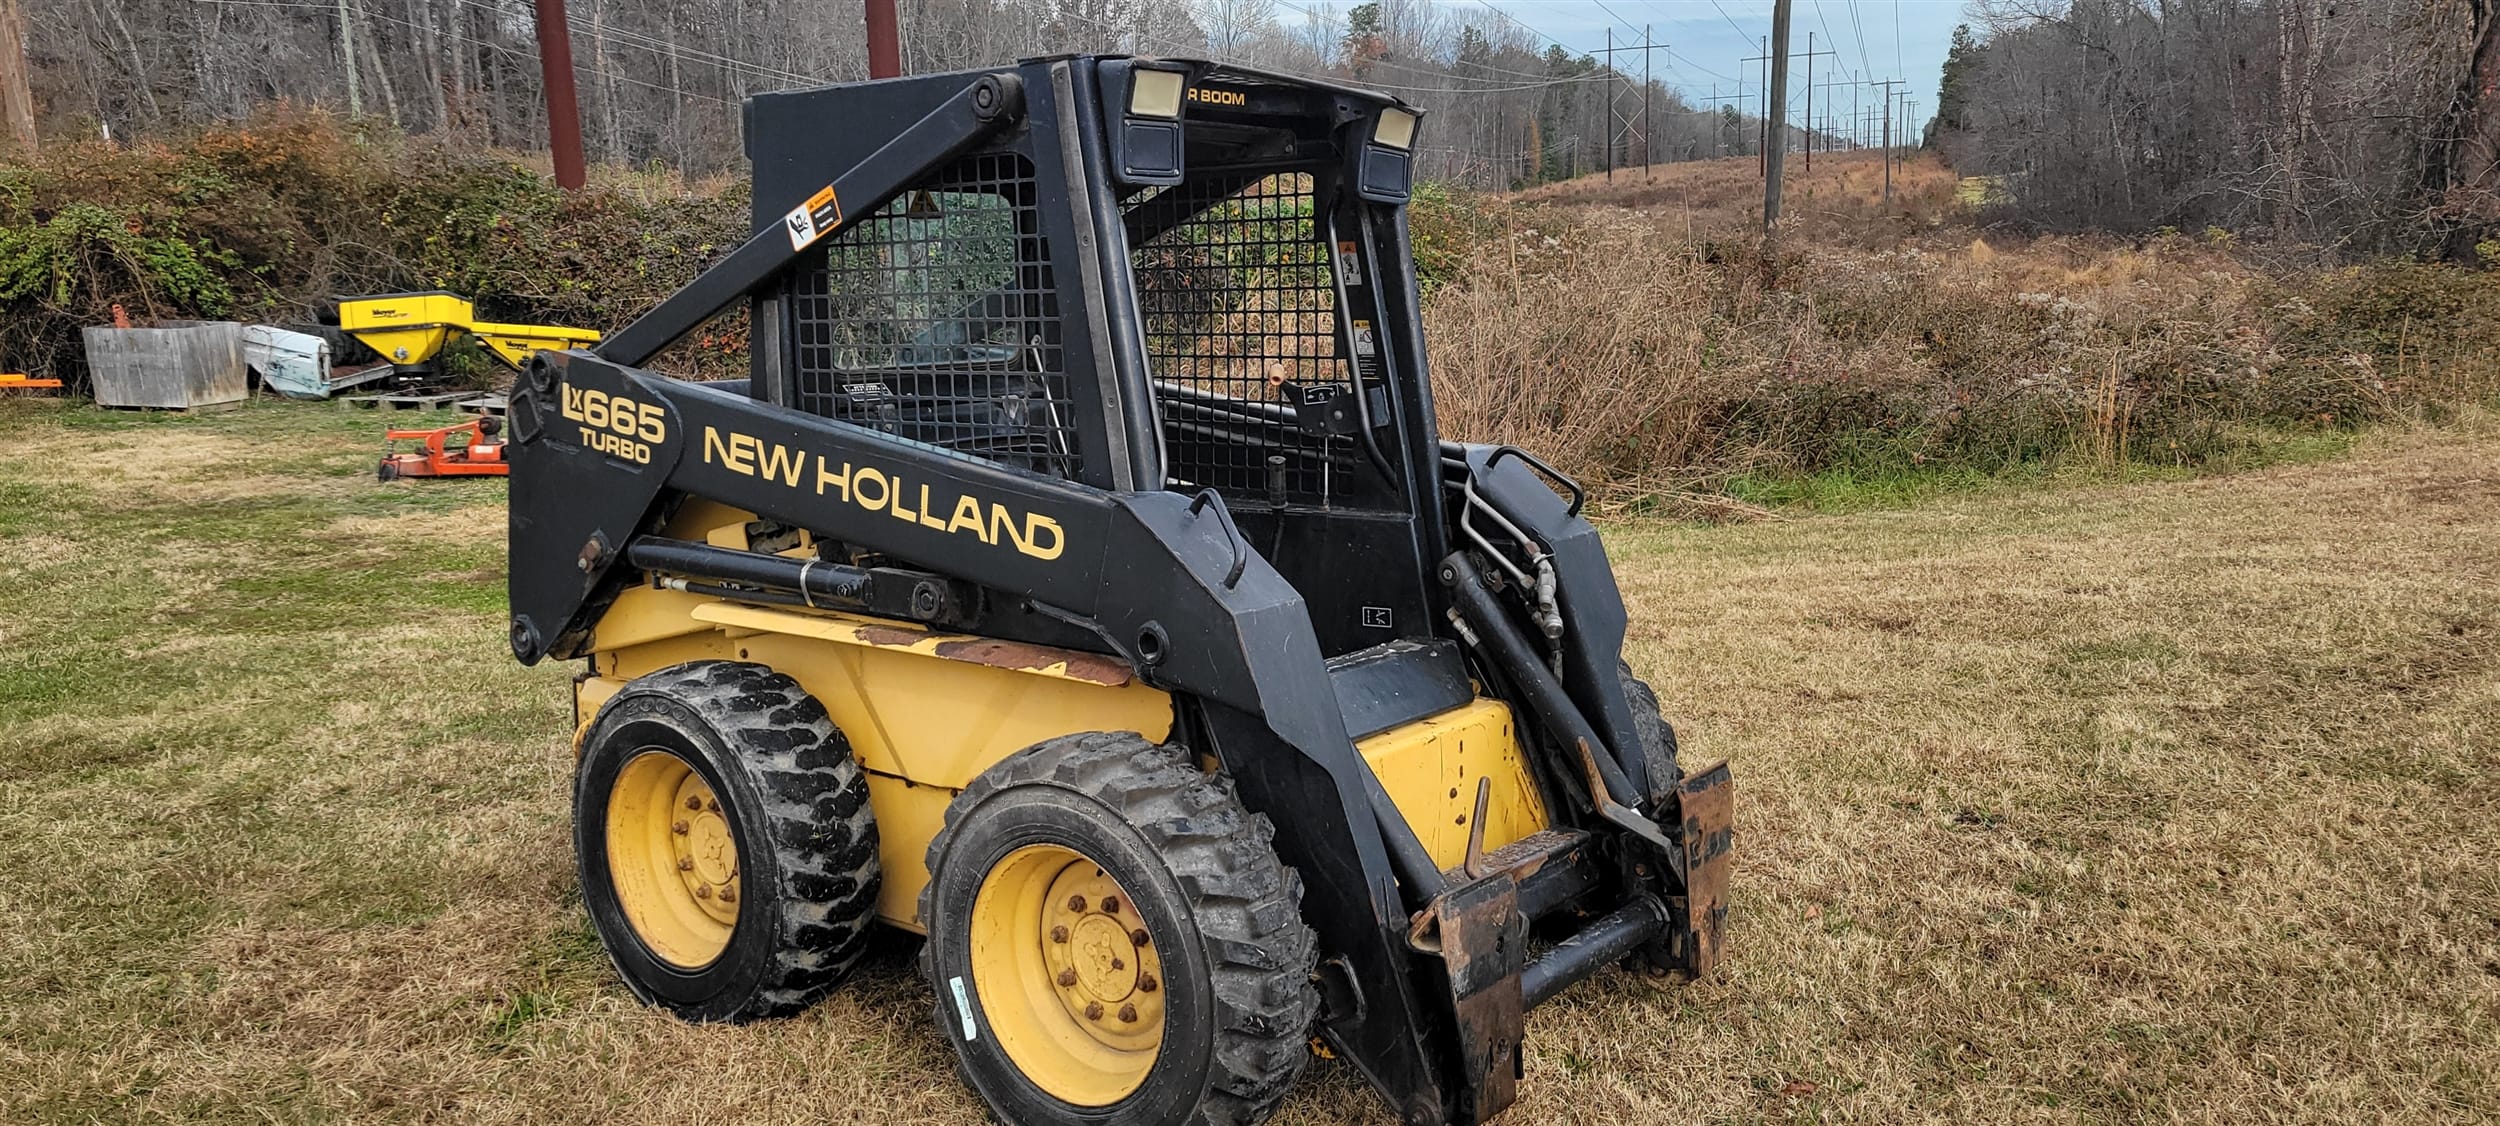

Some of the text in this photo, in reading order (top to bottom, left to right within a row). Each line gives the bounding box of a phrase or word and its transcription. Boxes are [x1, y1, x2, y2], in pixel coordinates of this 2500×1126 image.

[1200, 89, 1245, 106] BOOM
[578, 426, 651, 465] TURBO
[704, 426, 1066, 561] NEW HOLLAND
